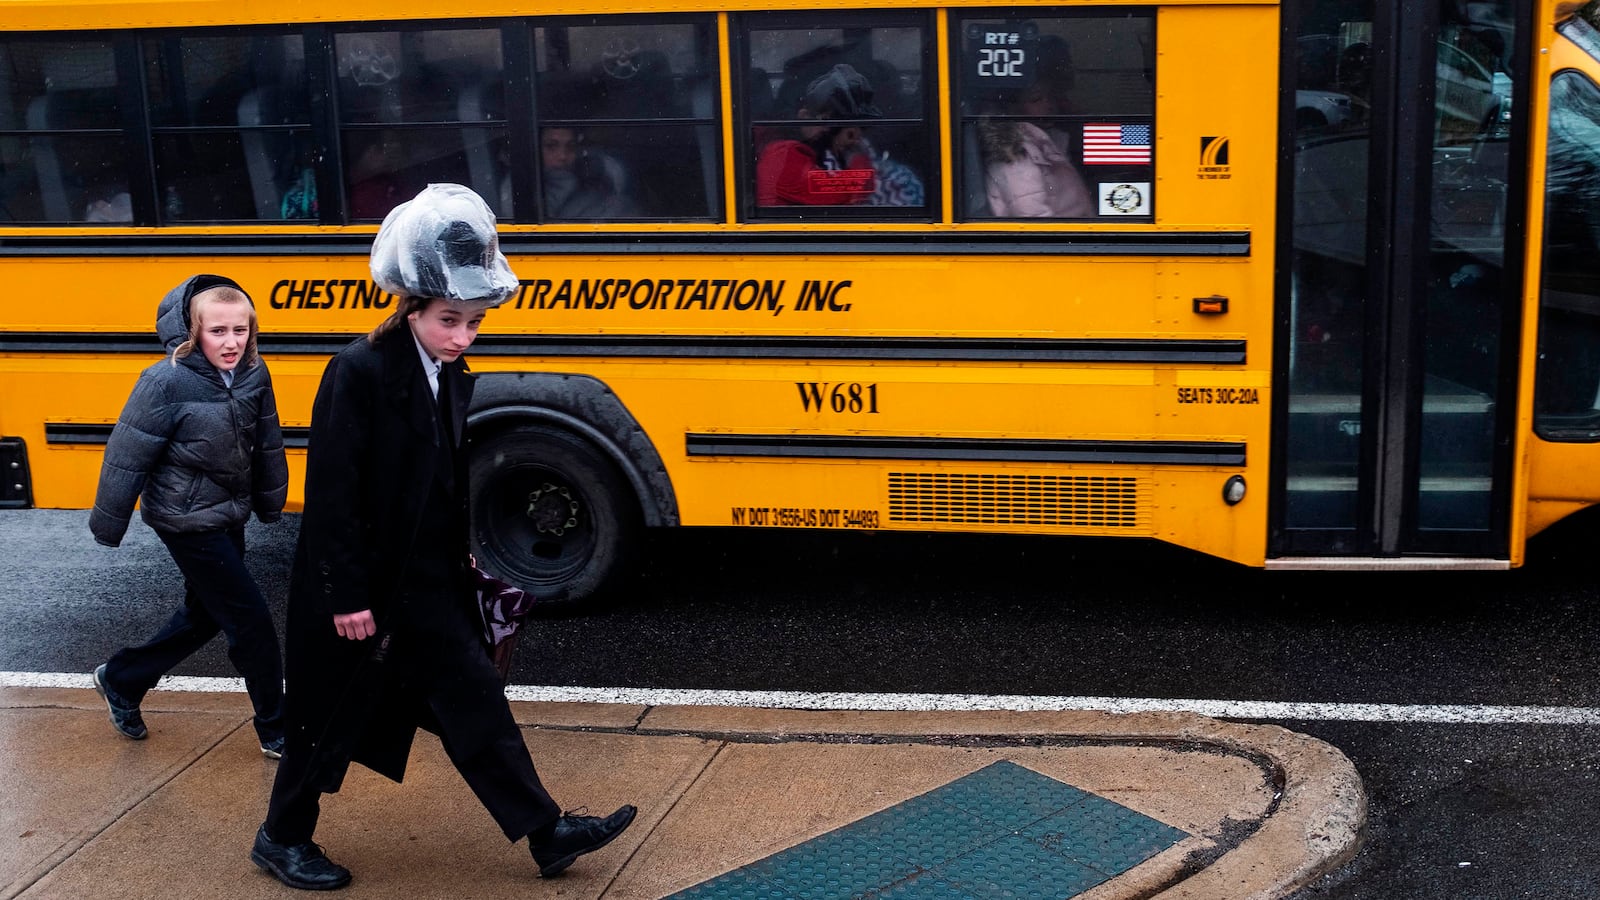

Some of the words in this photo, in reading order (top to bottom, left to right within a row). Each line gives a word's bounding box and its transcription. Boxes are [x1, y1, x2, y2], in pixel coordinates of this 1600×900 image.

[985, 32, 1020, 45] RT#
[978, 49, 1025, 77] 202
[270, 279, 394, 310] CHESTNU
[514, 278, 786, 317] TRANSPORTATION,
[793, 280, 853, 312] INC.
[794, 382, 881, 414] W681
[1177, 387, 1213, 404] SEATS
[1215, 388, 1259, 404] 30C-20A
[731, 507, 746, 526] NY
[749, 507, 770, 526] DOT
[819, 509, 841, 528] DOT
